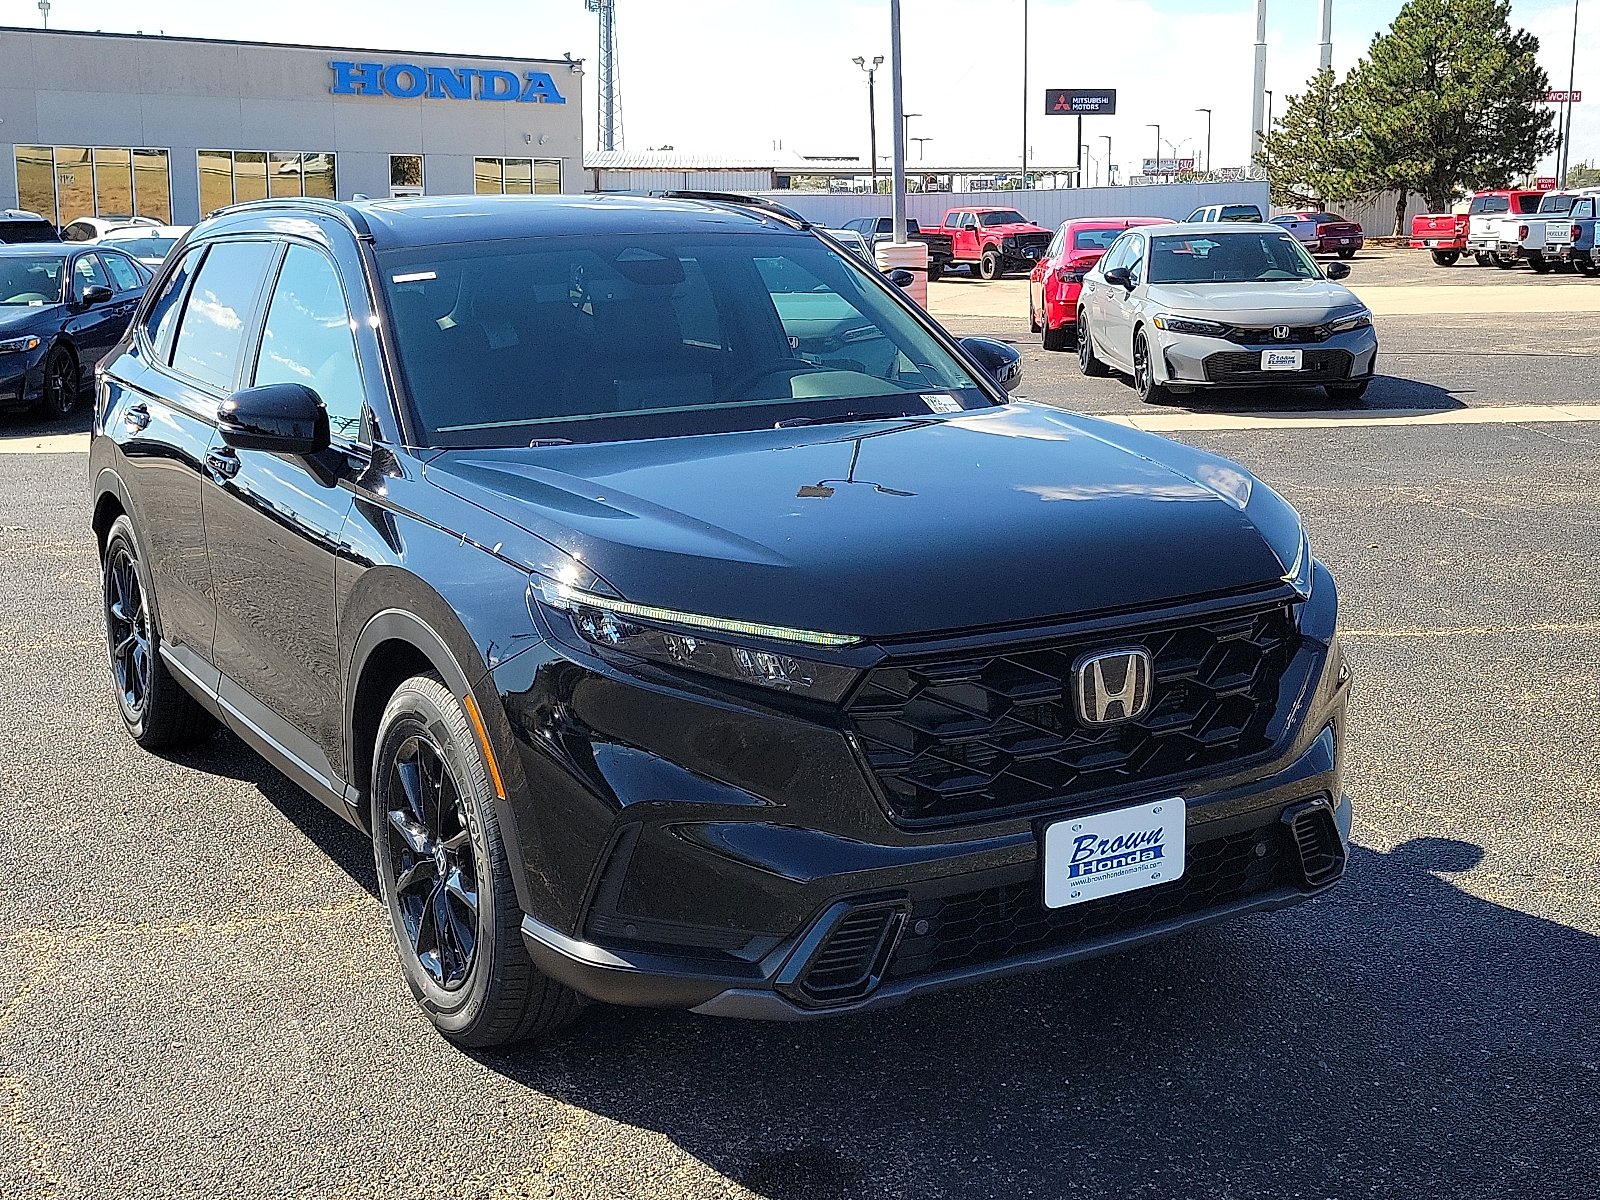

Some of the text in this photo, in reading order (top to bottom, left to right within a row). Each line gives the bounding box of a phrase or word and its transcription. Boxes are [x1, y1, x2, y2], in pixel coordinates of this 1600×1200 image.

[329, 61, 566, 104] HONDA
[1072, 103, 1100, 111] MOTORS
[1070, 826, 1165, 863] Brown
[1078, 850, 1156, 875] Honda
